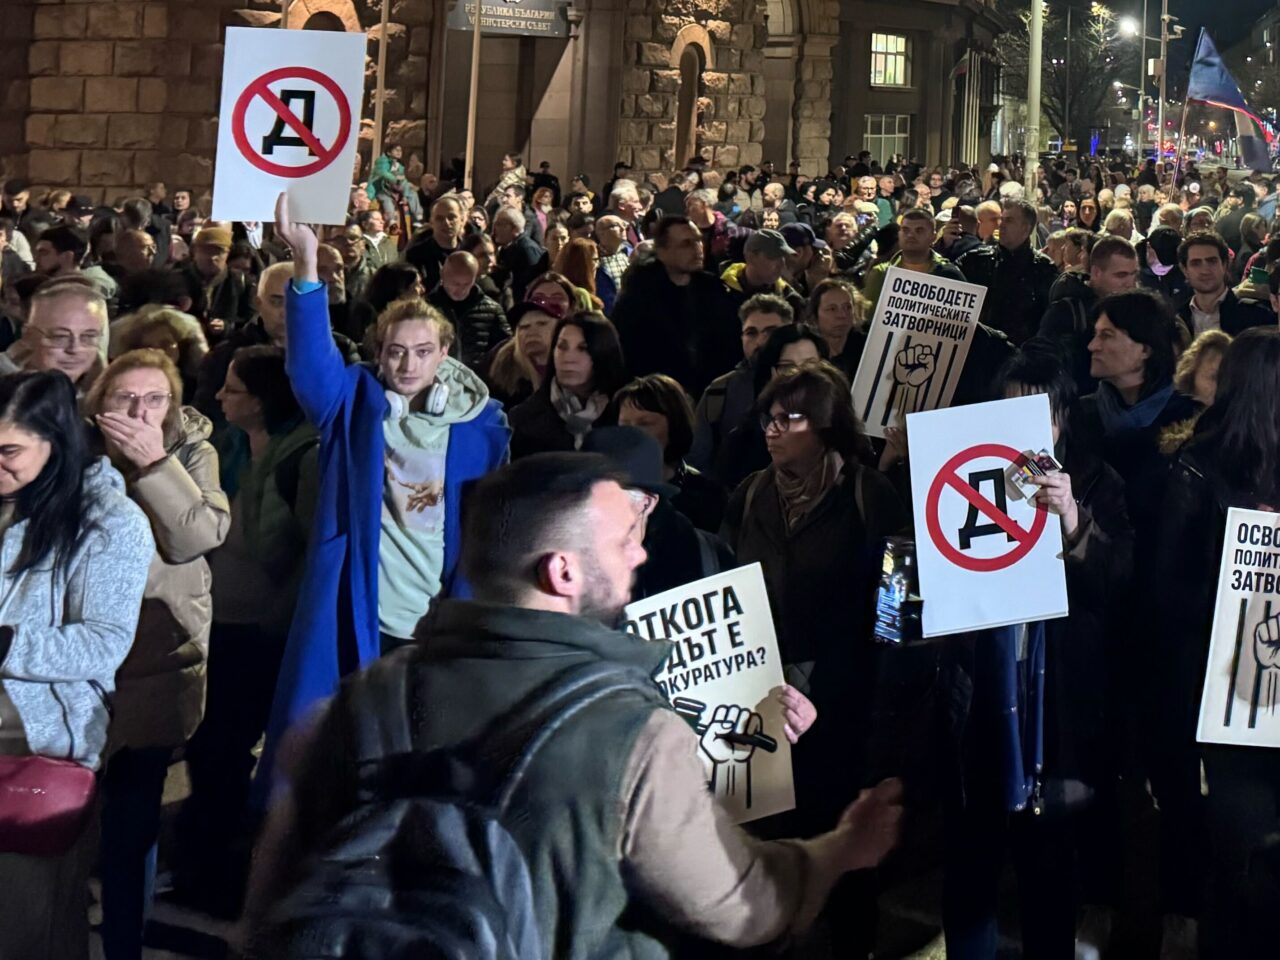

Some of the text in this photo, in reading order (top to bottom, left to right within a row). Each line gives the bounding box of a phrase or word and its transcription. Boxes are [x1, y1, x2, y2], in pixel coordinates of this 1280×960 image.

[465, 3, 513, 17] РЕУБЛИКА
[468, 15, 526, 28] МНИСТЕРСКИ
[262, 89, 320, 156] Д
[892, 277, 977, 309] ОСВОБОДЕТЕ
[887, 295, 971, 324] ПОЛИТИЧЕСКИТЕ
[882, 310, 969, 341] ЗАТВОРНИЦИ
[958, 468, 1018, 550] Д
[667, 620, 745, 674] ДЪТ Е
